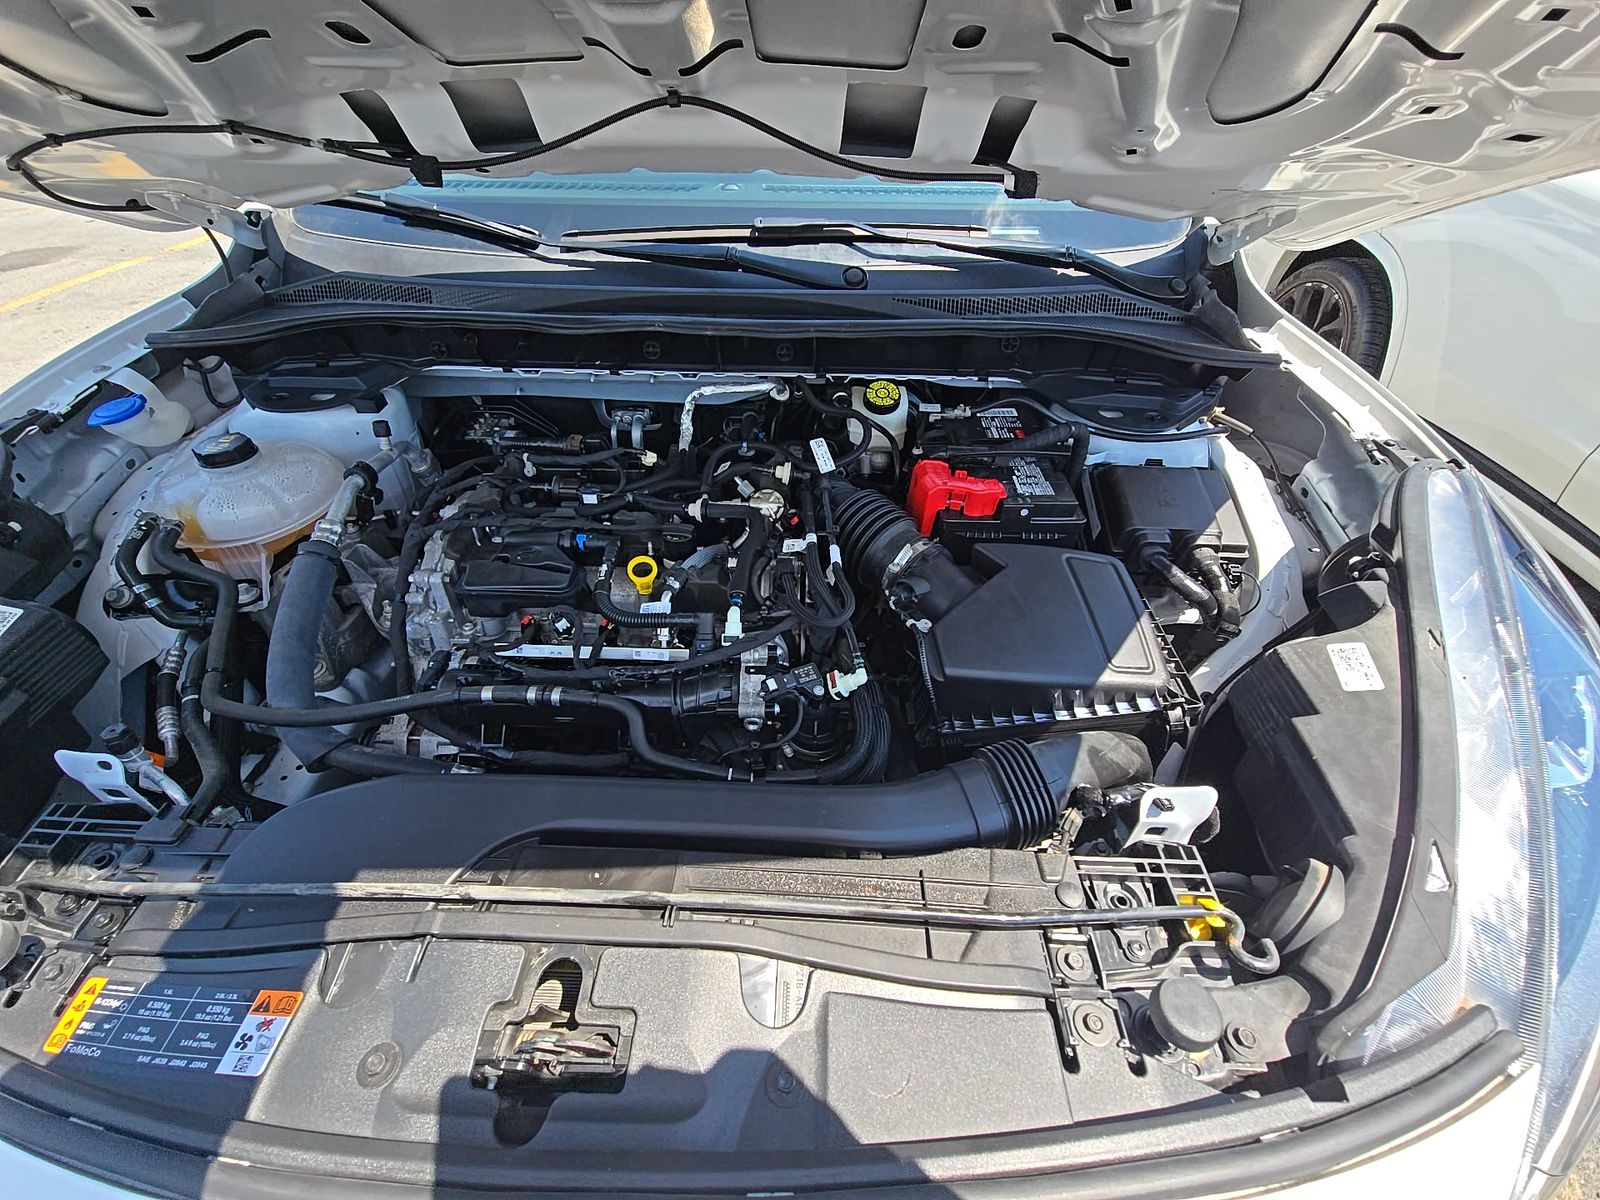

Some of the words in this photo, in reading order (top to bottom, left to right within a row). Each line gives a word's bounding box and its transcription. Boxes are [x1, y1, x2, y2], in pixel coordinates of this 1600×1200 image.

[162, 1002, 171, 1012] kg
[222, 1006, 231, 1016] kg
[79, 1021, 96, 1030] PAG
[137, 1026, 151, 1034] PAG
[196, 1032, 210, 1040] PAG
[64, 1043, 102, 1058] FoMoCo
